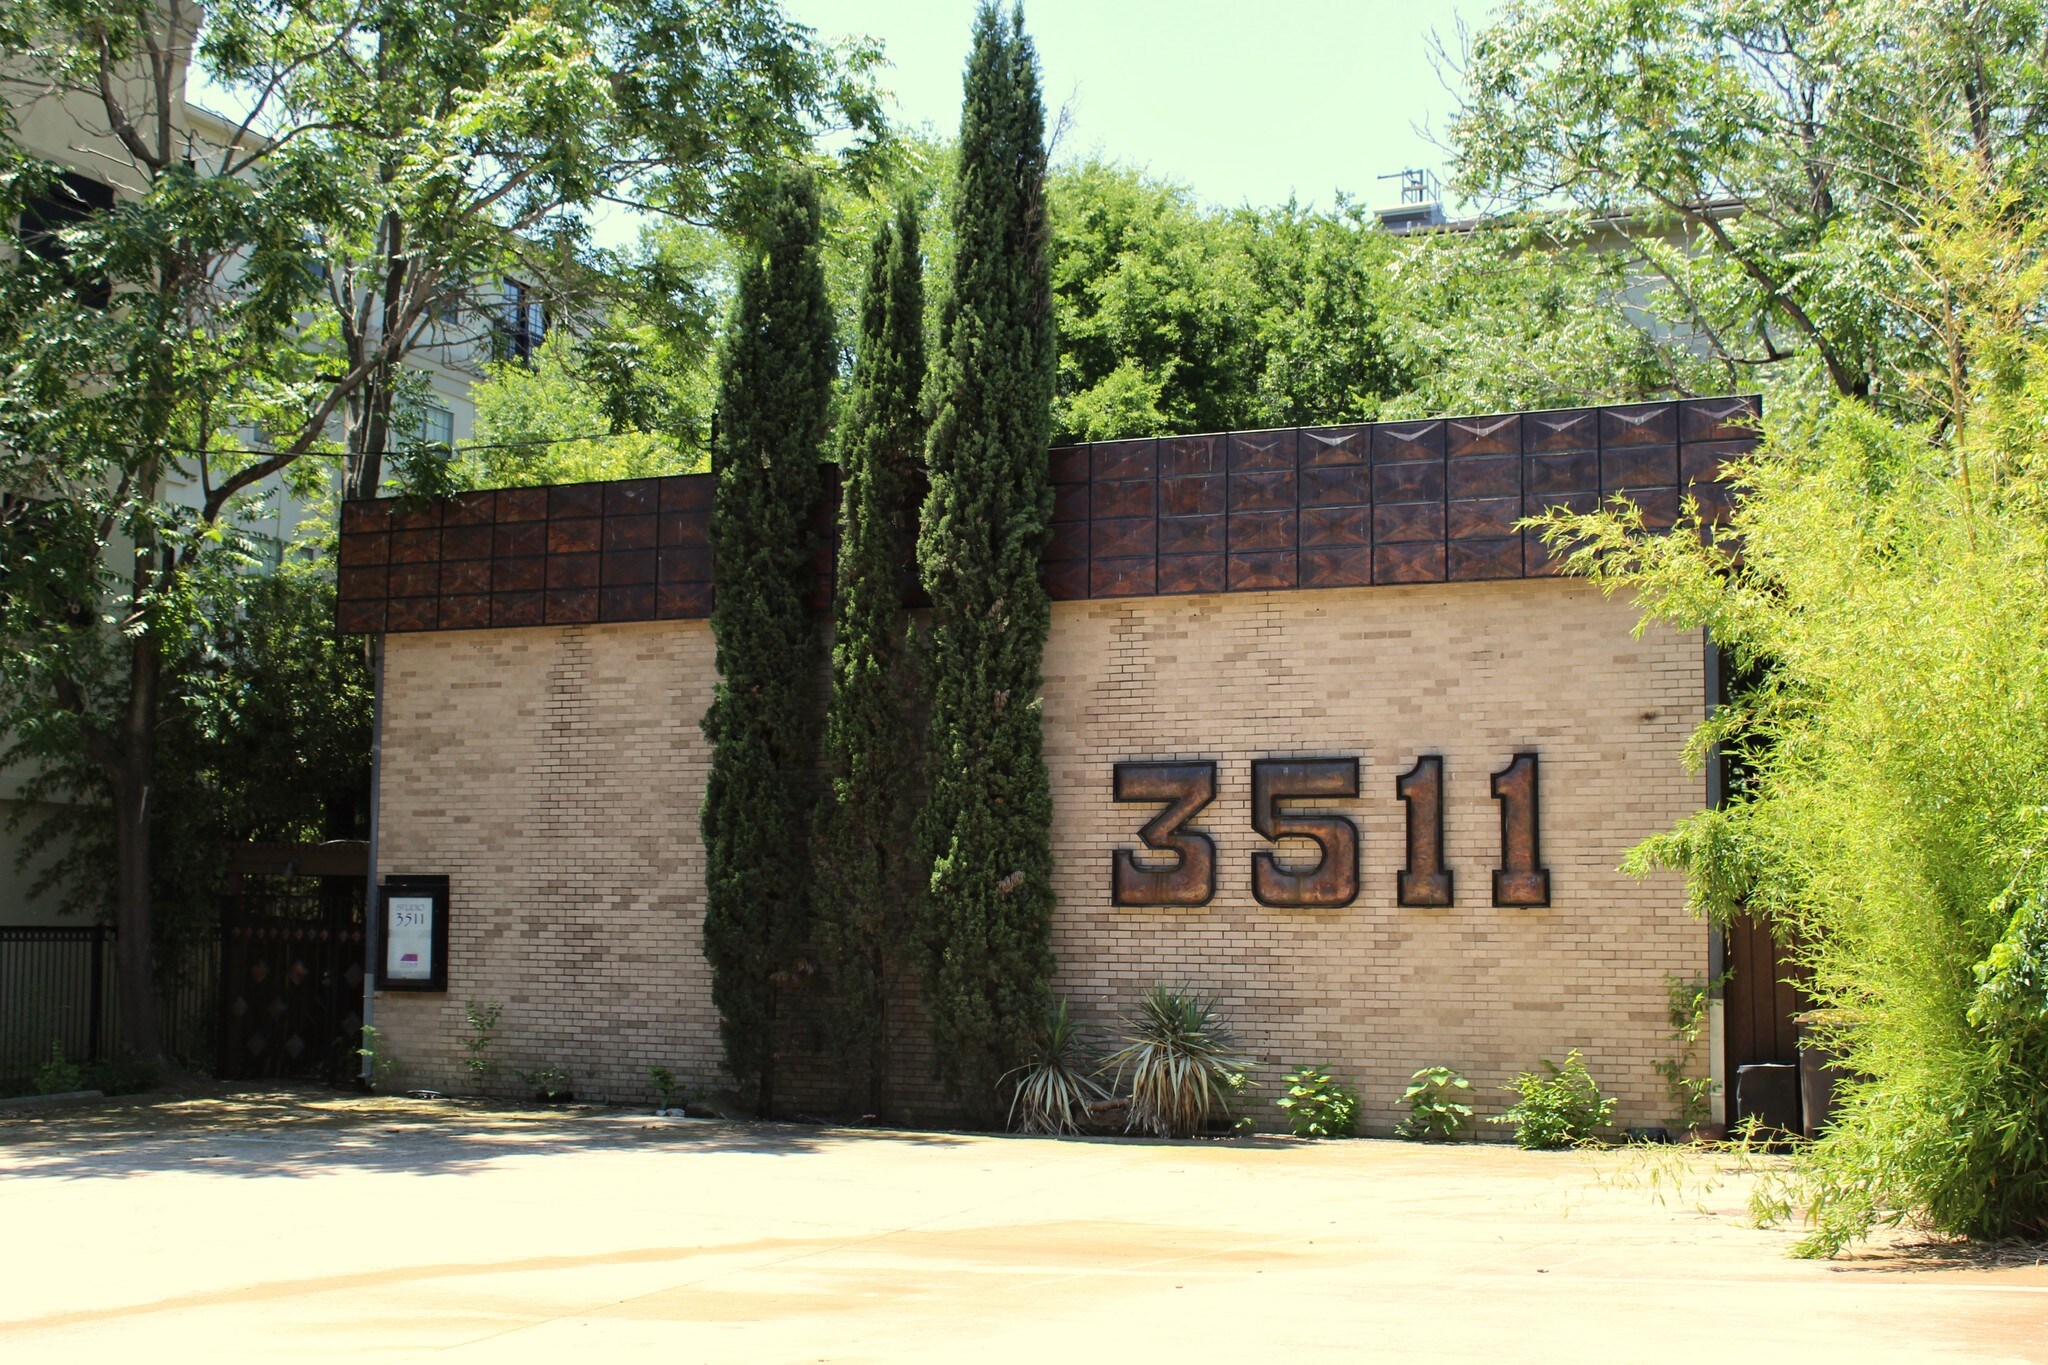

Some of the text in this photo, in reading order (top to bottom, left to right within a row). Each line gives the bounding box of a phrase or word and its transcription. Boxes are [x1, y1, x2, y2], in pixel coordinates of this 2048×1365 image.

[1112, 752, 1550, 908] 3511
[395, 903, 425, 911] STUDIO
[395, 912, 424, 927] 3511
